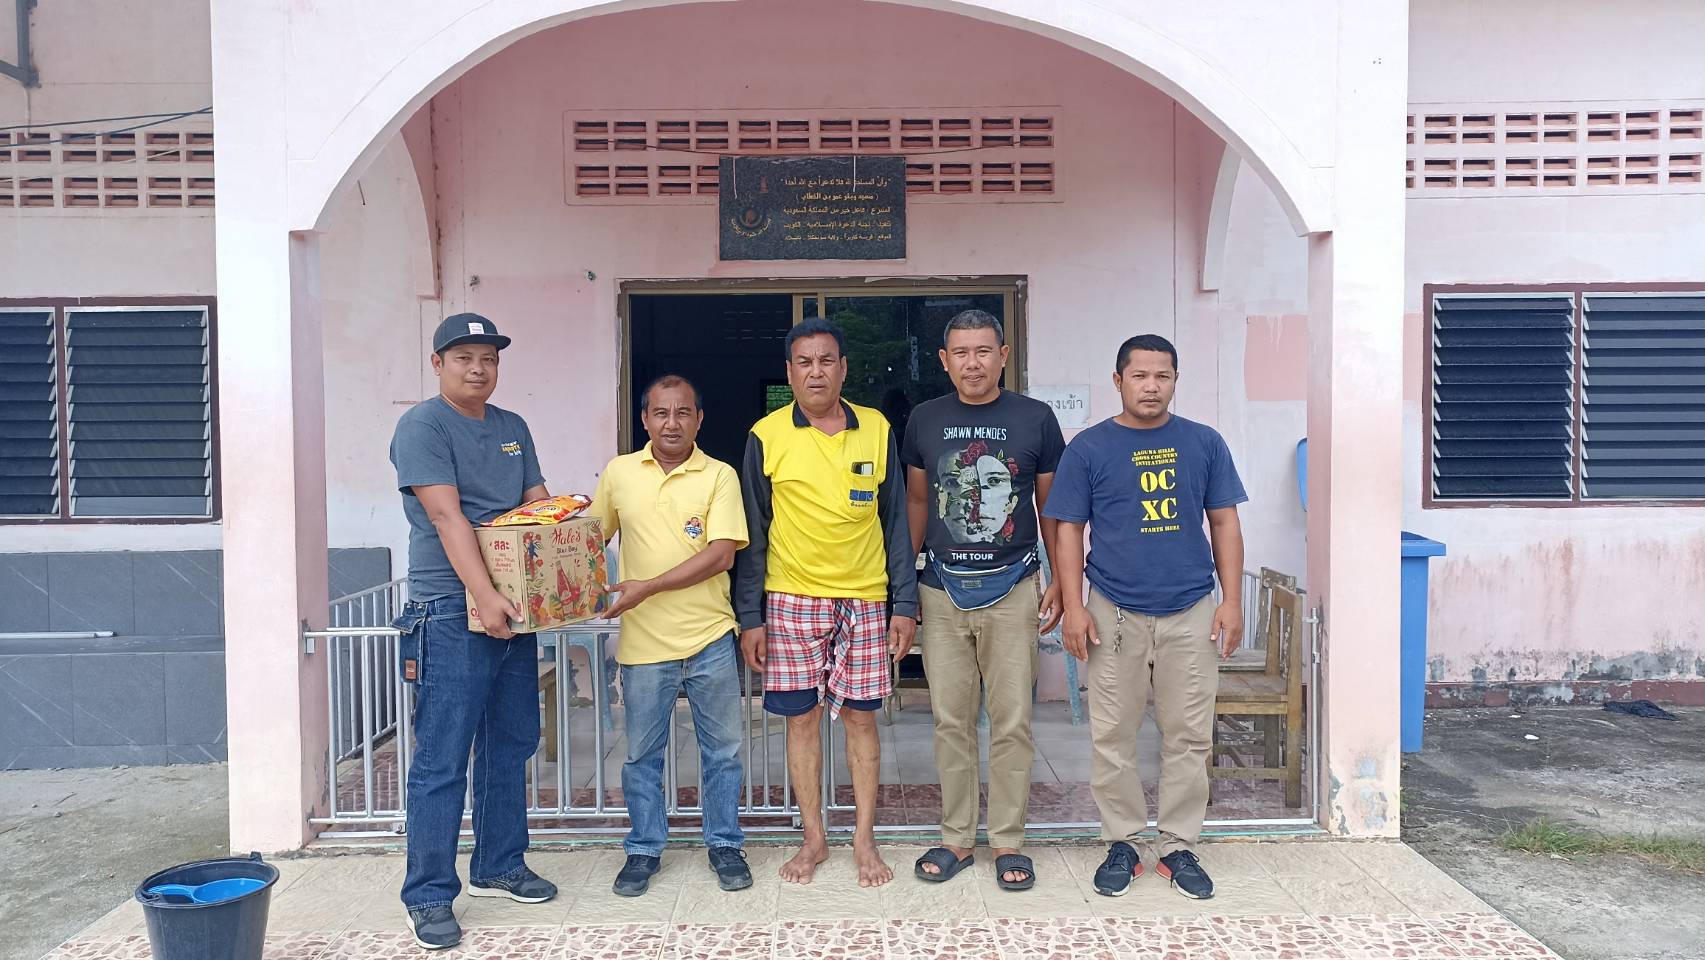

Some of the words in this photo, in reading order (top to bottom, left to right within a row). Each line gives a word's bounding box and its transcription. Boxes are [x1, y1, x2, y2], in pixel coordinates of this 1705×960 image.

[1043, 393, 1083, 410] างเข้า
[943, 426, 972, 440] SHAWN
[973, 426, 1007, 441] MENDES
[1135, 458, 1176, 466] INVITATIONAL
[1140, 468, 1176, 493] OC
[1141, 497, 1178, 521] XC
[951, 552, 968, 560] THE
[969, 553, 994, 561] TOUR
